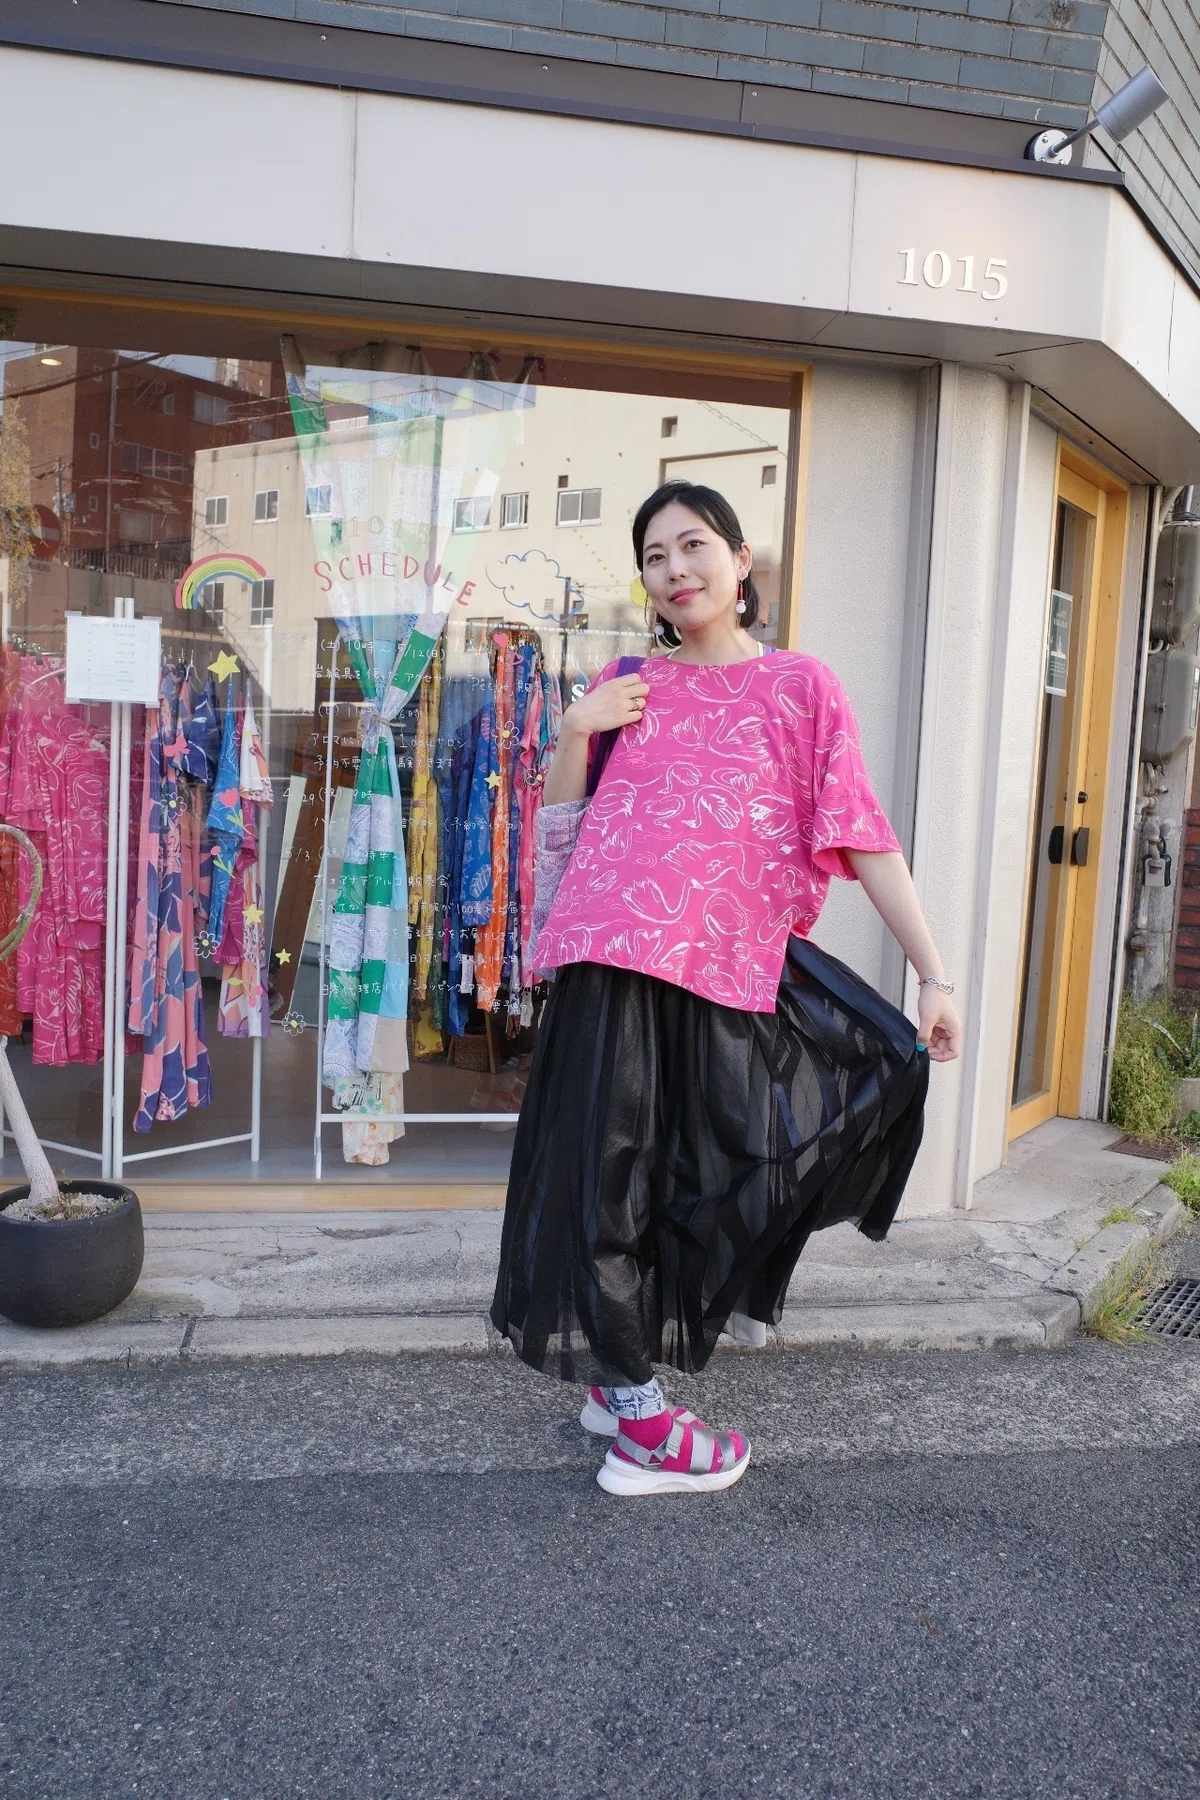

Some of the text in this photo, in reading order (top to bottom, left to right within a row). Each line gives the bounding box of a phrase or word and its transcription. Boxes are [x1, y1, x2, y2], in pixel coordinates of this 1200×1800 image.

[897, 247, 1009, 301] 1015
[314, 551, 477, 607] SCHEDULE
[571, 683, 585, 702] S
